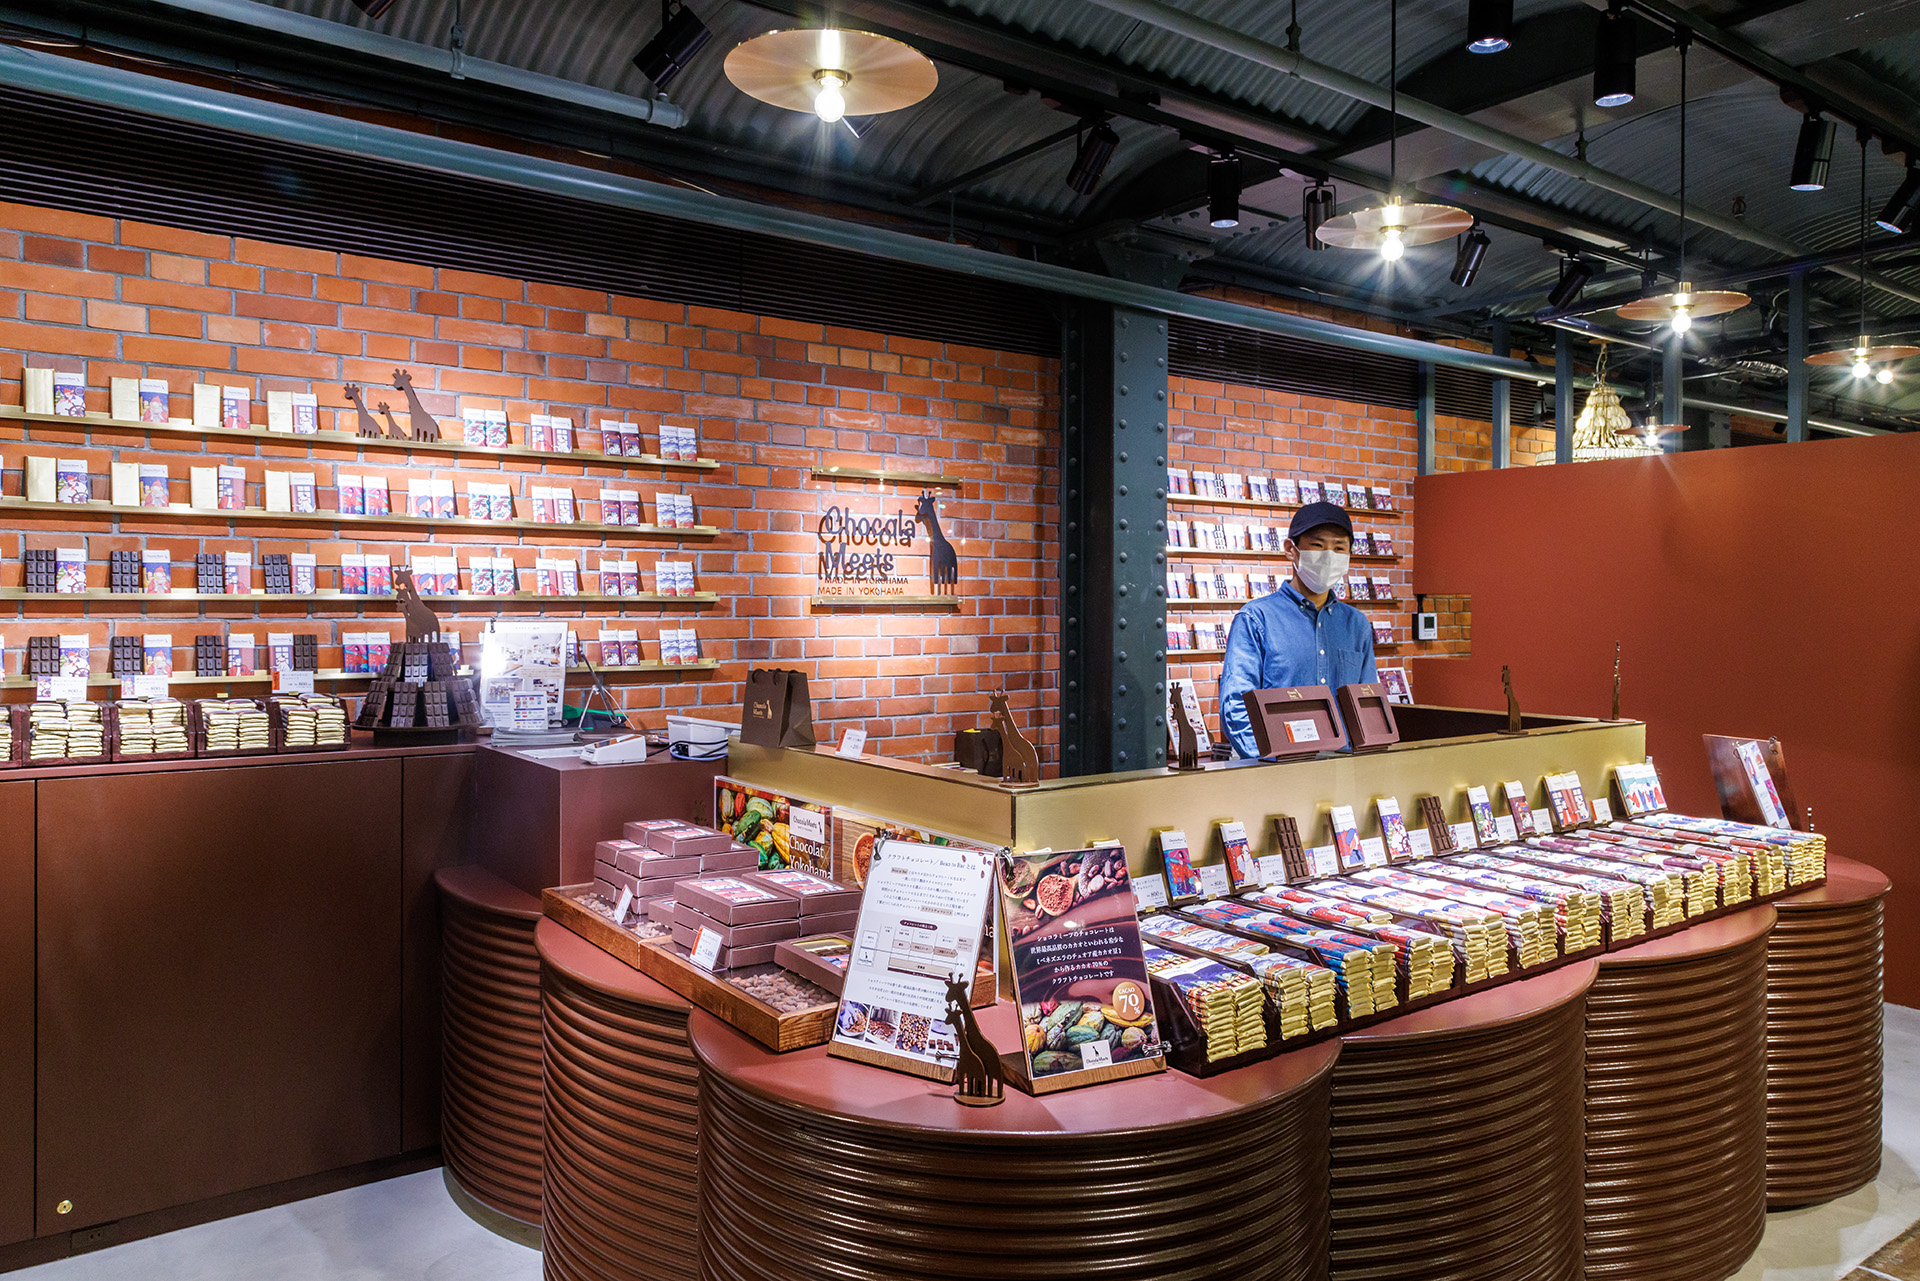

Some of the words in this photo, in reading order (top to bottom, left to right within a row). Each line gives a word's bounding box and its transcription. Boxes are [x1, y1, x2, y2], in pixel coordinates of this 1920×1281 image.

[825, 506, 916, 539] Chocola
[825, 542, 894, 571] Meets
[789, 835, 824, 859] Chocolat
[789, 854, 832, 880] Yokohama
